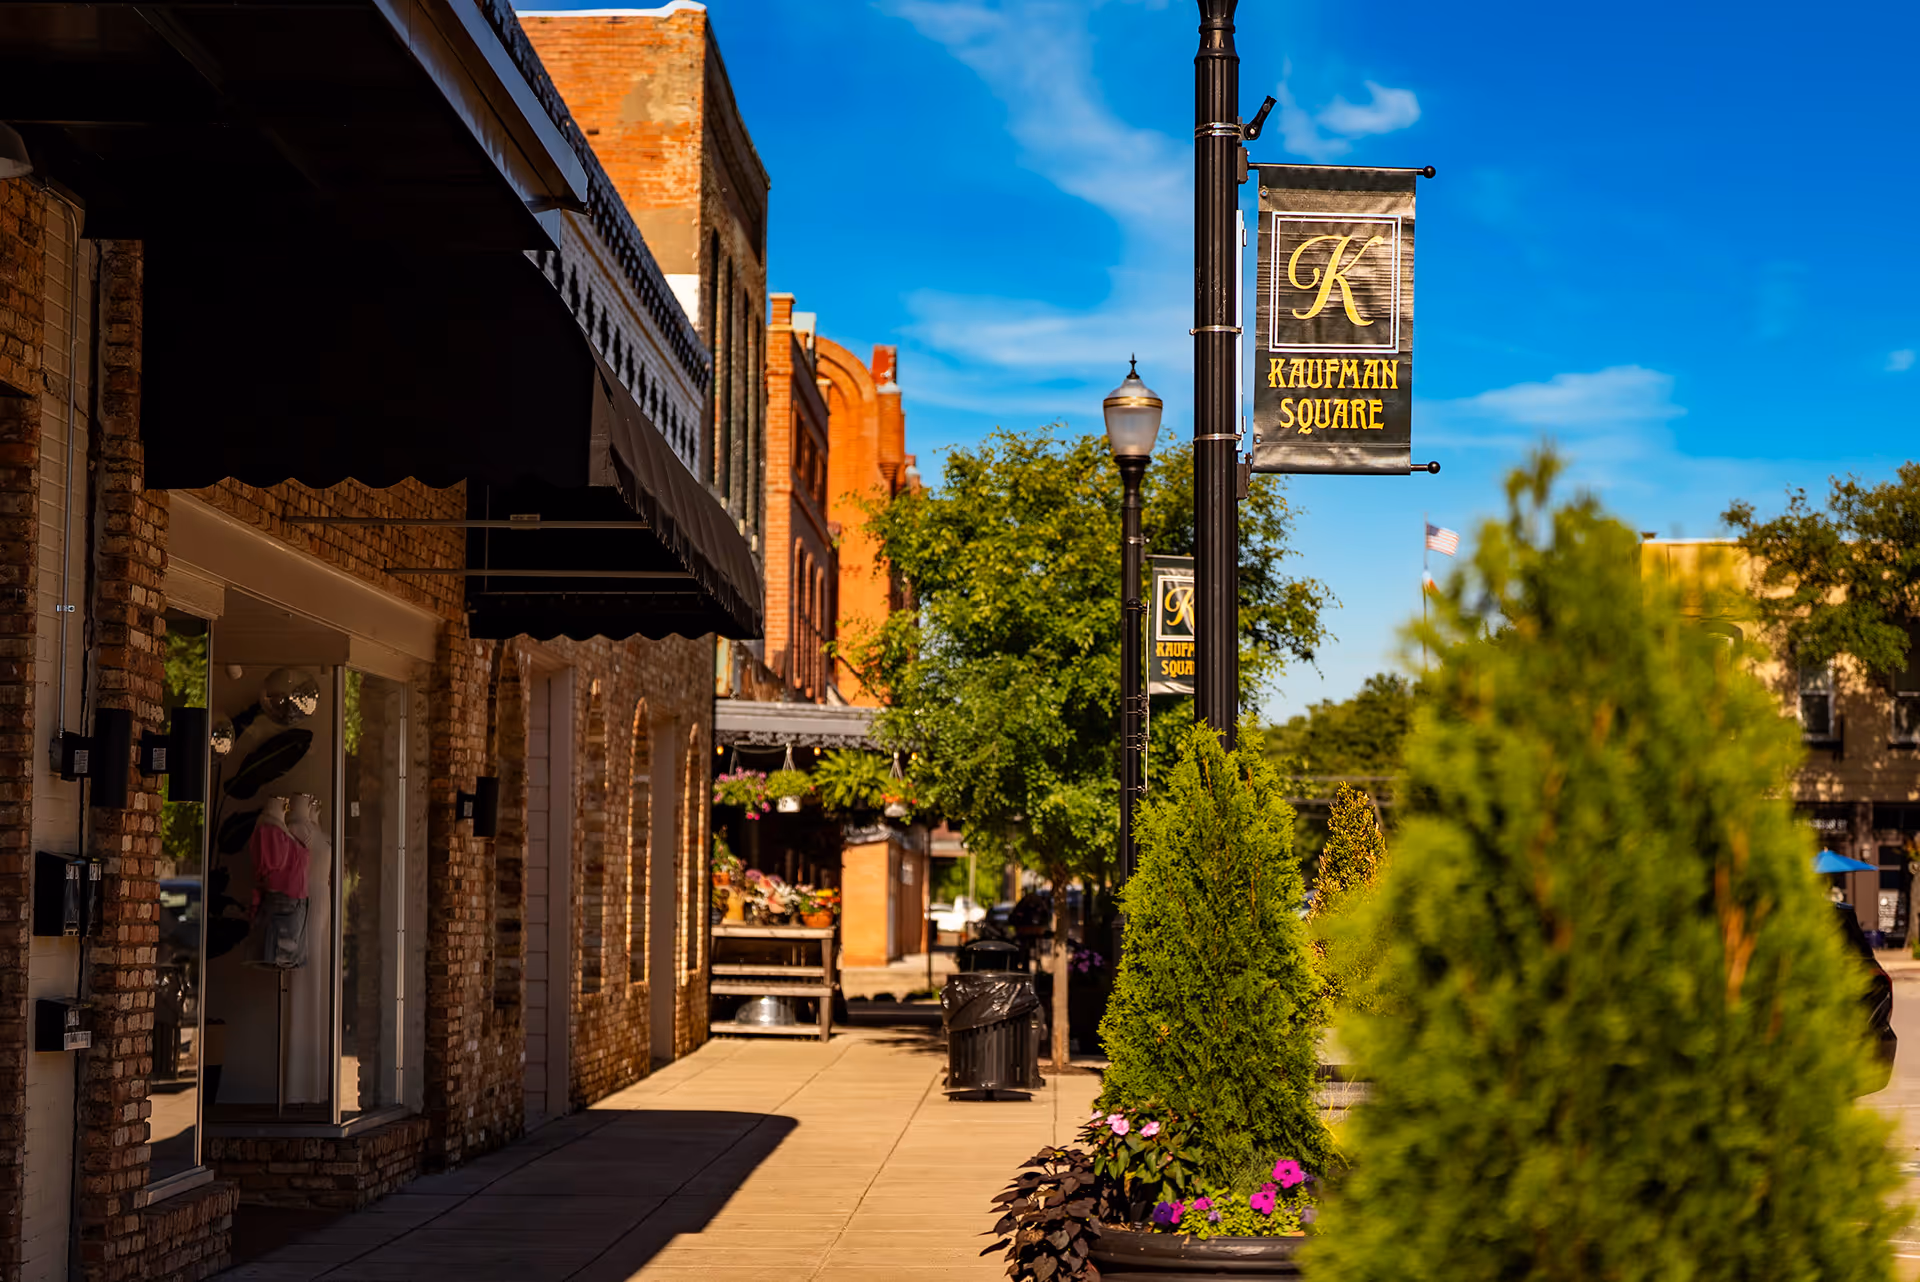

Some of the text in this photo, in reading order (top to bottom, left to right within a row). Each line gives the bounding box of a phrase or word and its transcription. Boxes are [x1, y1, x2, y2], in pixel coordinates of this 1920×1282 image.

[1288, 235, 1384, 326] K
[1268, 358, 1399, 389] KAUFMAN
[1280, 398, 1384, 435] SQUARE
[1164, 586, 1194, 626] K
[1161, 660, 1194, 678] SQUA
